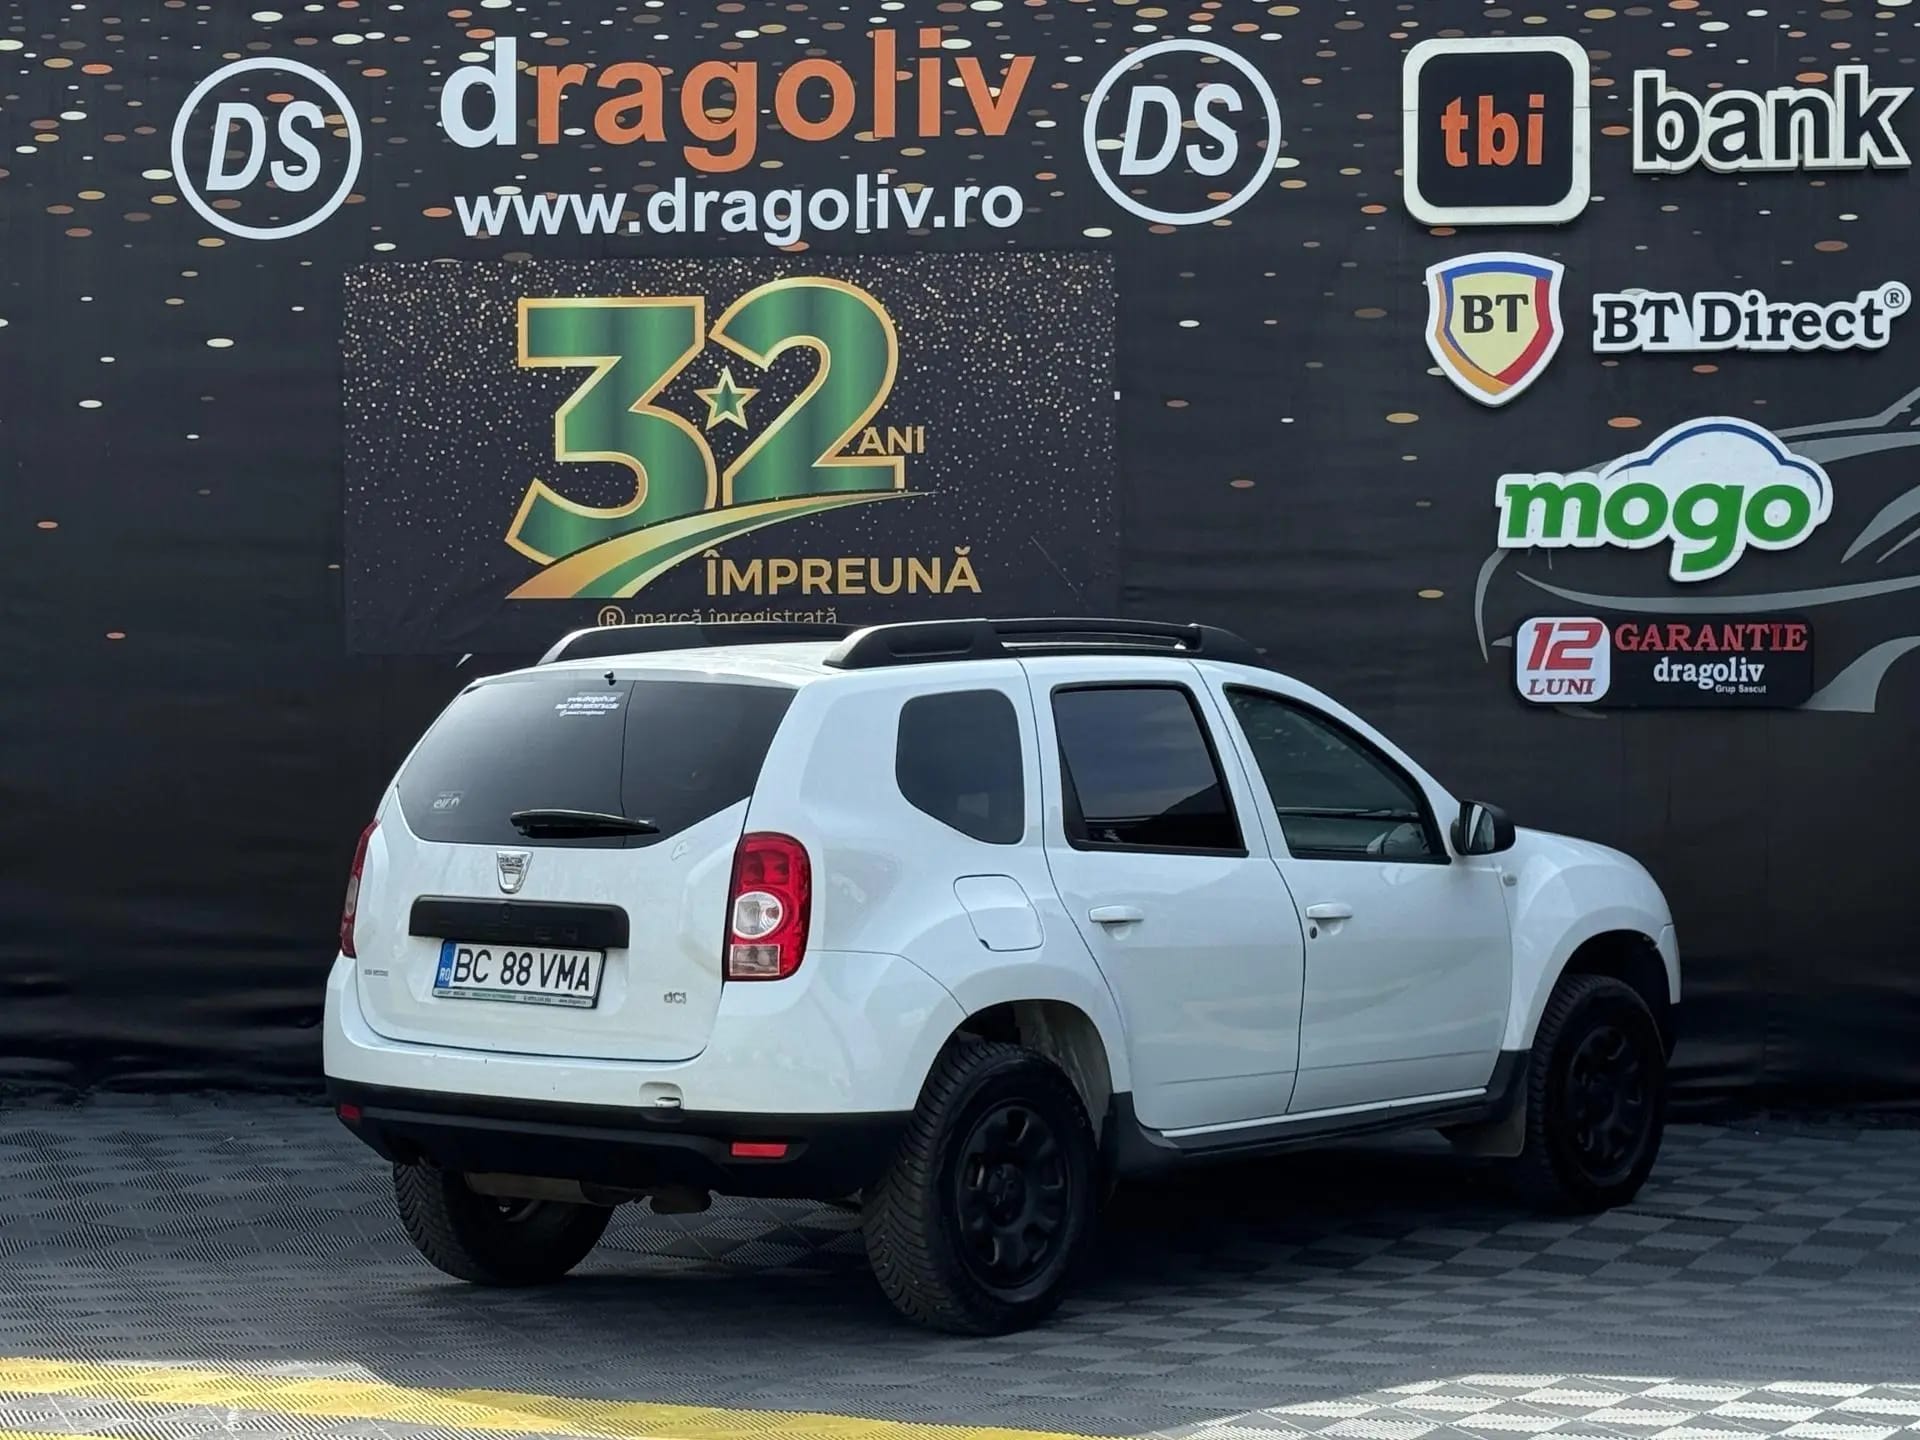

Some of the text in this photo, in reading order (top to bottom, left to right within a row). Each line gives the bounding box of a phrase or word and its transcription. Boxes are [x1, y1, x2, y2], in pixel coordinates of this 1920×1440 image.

[440, 28, 1037, 173] dragoliv
[1440, 70, 1907, 168] tbi bank
[206, 100, 326, 192] DS
[1120, 82, 1244, 177] DS
[454, 173, 1024, 247] www.dragoliv.ro
[1460, 293, 1529, 334] BT
[1600, 298, 1680, 345] BT
[504, 275, 906, 566] 32
[857, 425, 926, 456] ANI
[1503, 482, 1812, 574] mogo
[704, 547, 982, 596] ÎMPREUNĂ
[1526, 622, 1603, 671] 12
[1614, 622, 1808, 652] GARANTIE
[1527, 678, 1596, 696] LUNI
[1653, 657, 1765, 692] dragoliv
[1715, 684, 1767, 694] Grup Sascut
[438, 966, 451, 983] RO
[453, 948, 591, 992] BC 88 VMA
